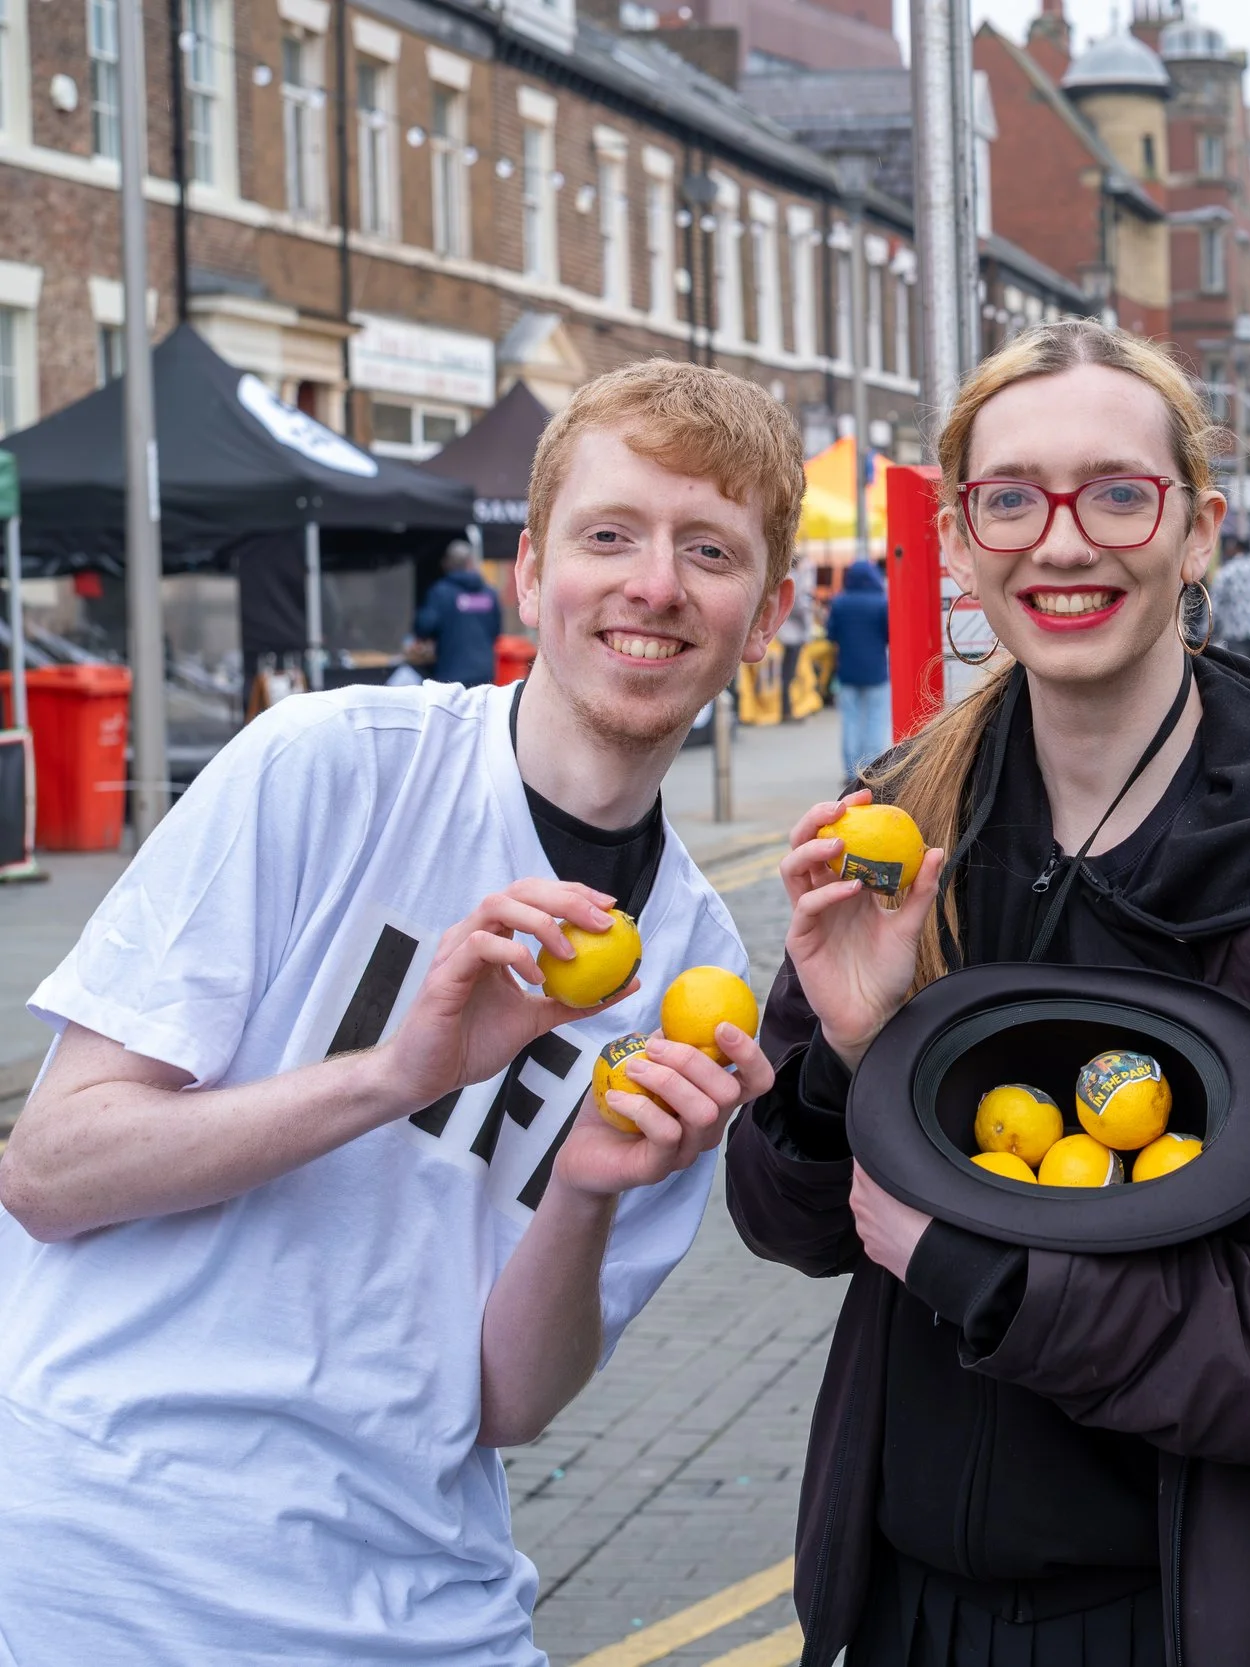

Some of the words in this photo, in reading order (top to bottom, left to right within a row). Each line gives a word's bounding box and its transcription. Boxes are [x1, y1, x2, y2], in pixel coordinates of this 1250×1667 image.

[611, 1048, 625, 1061] IN
[626, 1040, 646, 1051] TH
[1092, 1091, 1106, 1107] IN
[1101, 1073, 1122, 1092] THE
[1120, 1063, 1151, 1078] PARK
